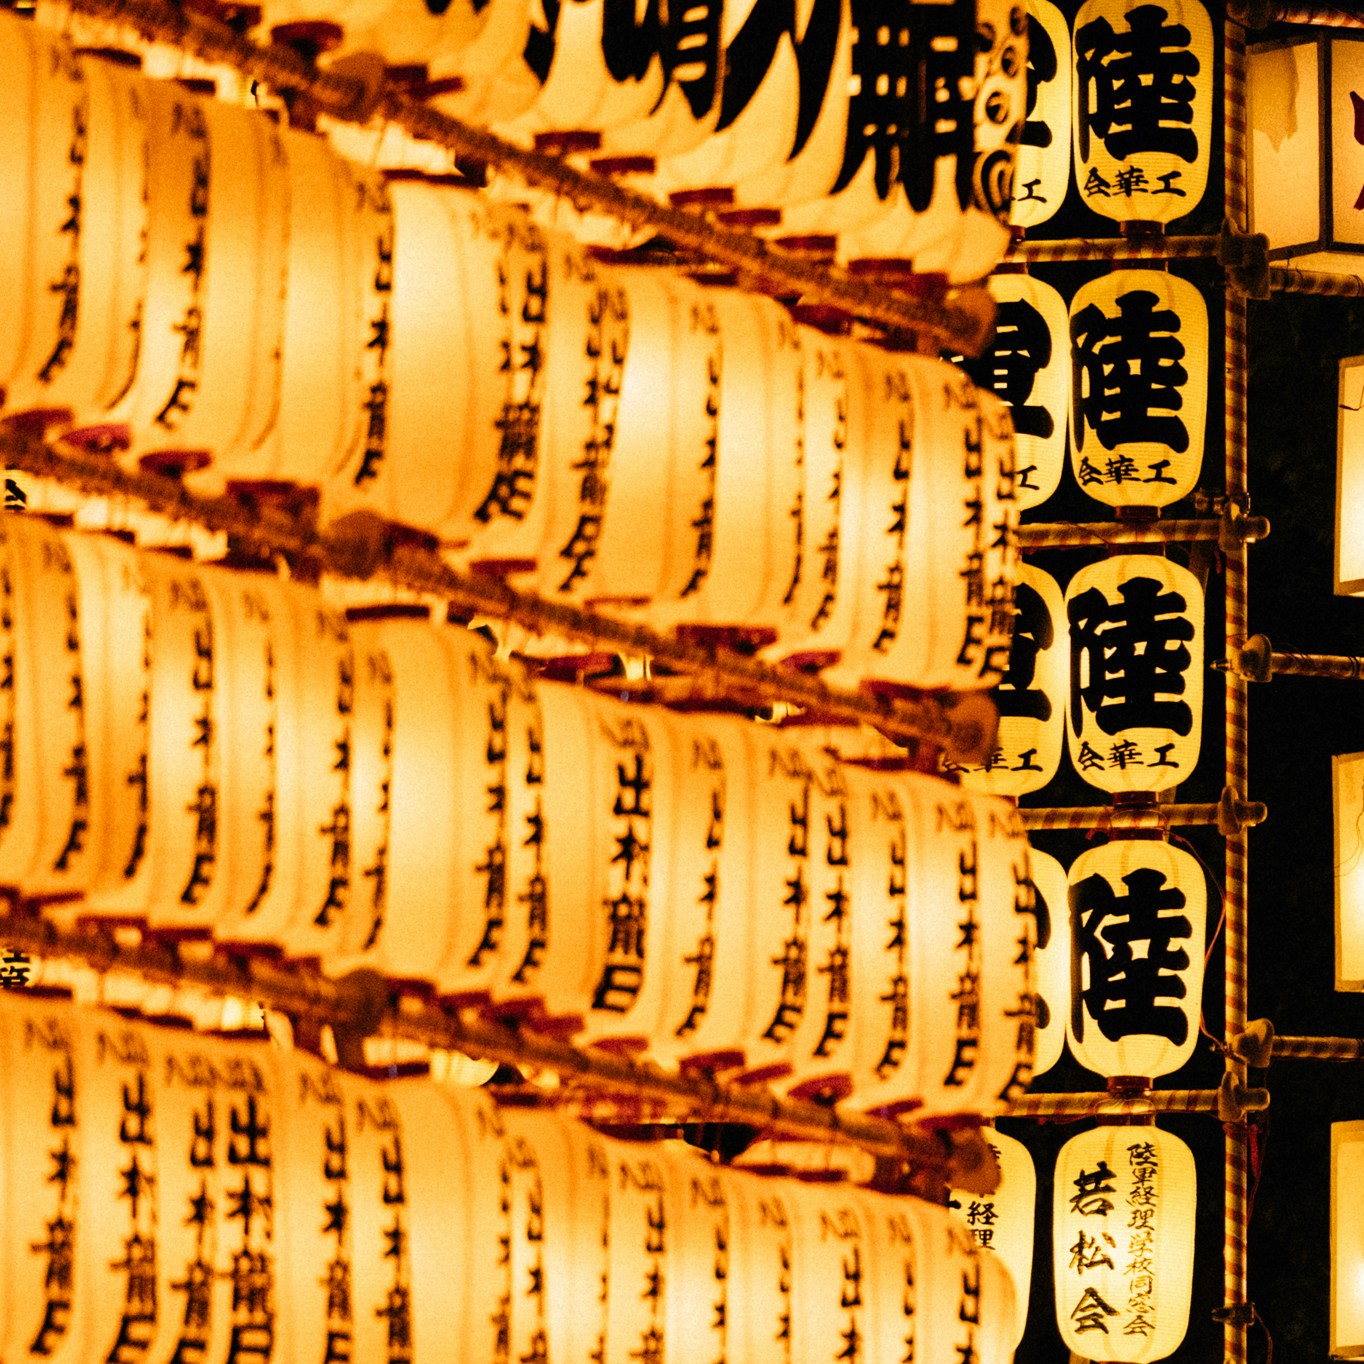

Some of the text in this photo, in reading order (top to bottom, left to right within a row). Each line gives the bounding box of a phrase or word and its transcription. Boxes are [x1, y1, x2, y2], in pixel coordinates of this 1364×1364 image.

[1075, 4, 1200, 163] 陸
[1070, 290, 1189, 453] 陸
[1067, 577, 1194, 738] 陸
[1069, 868, 1192, 1045] 陸
[1069, 1161, 1118, 1335] 若松会
